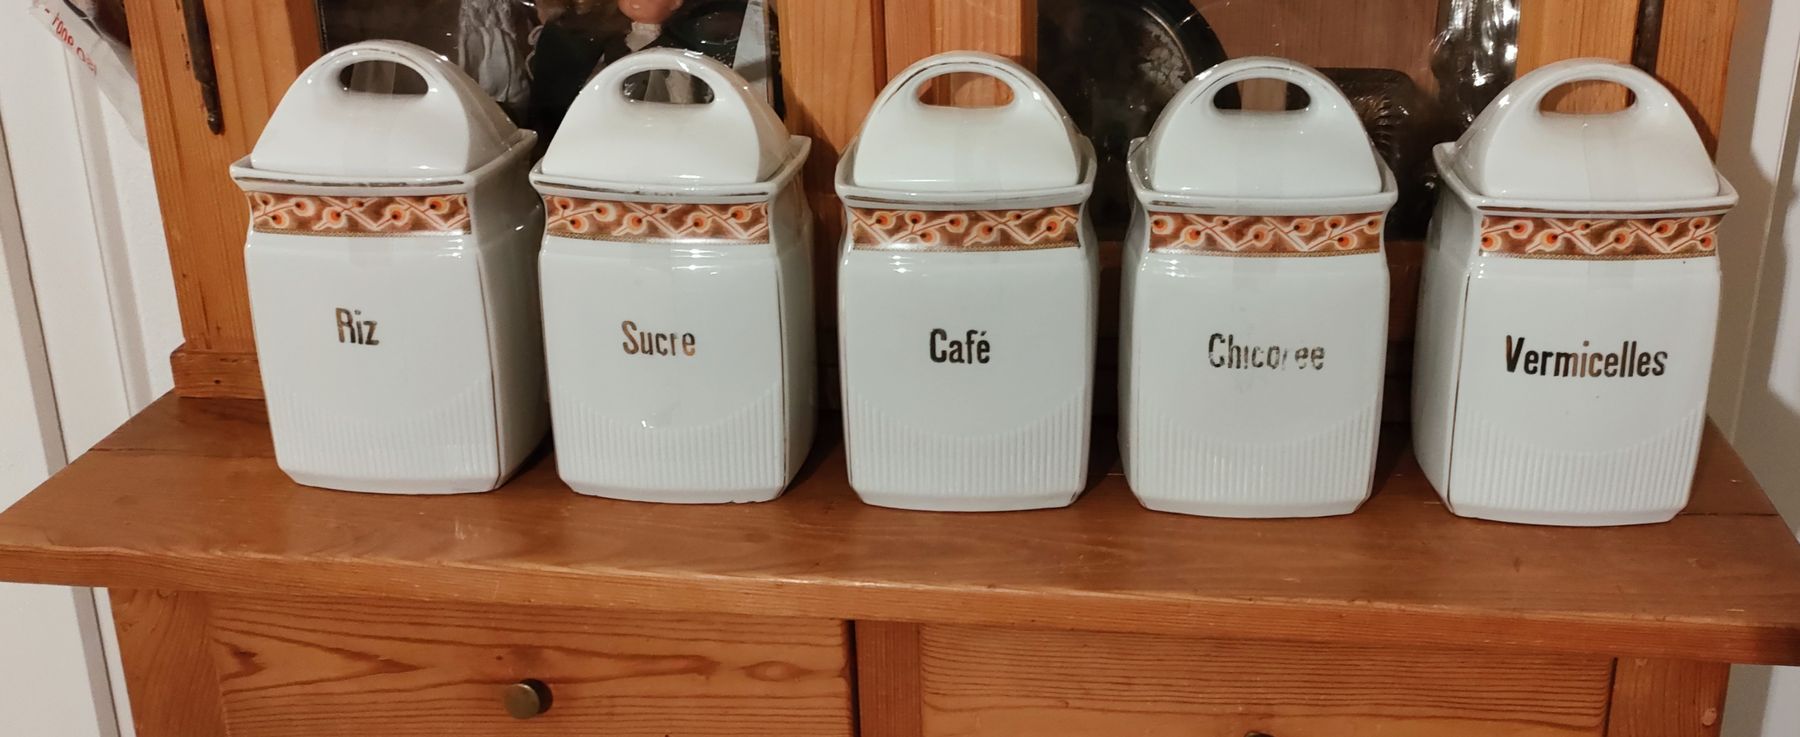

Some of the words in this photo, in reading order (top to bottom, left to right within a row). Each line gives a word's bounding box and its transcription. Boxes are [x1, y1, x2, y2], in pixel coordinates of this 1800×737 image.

[335, 307, 380, 346] Riz
[621, 320, 696, 357] Sucre
[929, 328, 990, 365] Café
[1505, 335, 1669, 378] Vermicelles
